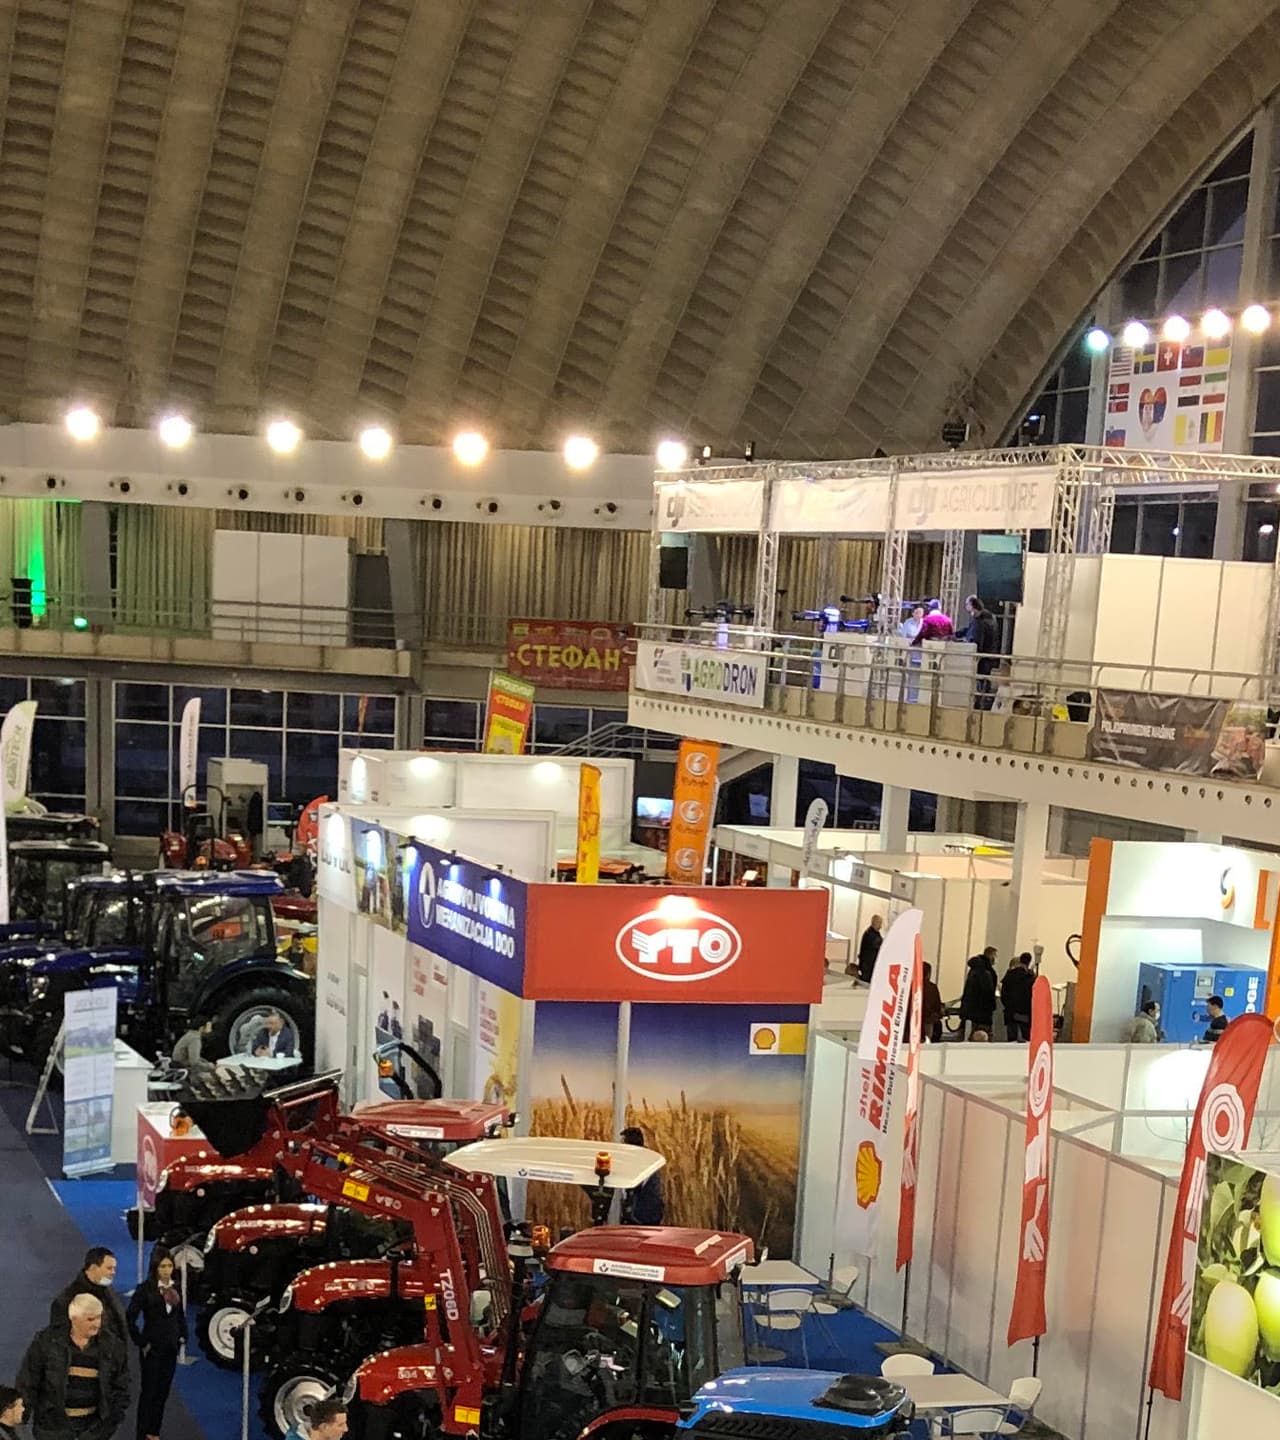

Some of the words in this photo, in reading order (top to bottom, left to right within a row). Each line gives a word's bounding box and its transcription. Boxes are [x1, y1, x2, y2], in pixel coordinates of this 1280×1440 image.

[942, 482, 1040, 513] AGRICULTURE
[517, 643, 620, 671] СТЕФАН
[691, 656, 758, 697] AGRODRON
[631, 928, 732, 964] YTO
[868, 963, 902, 1131] RIMULA
